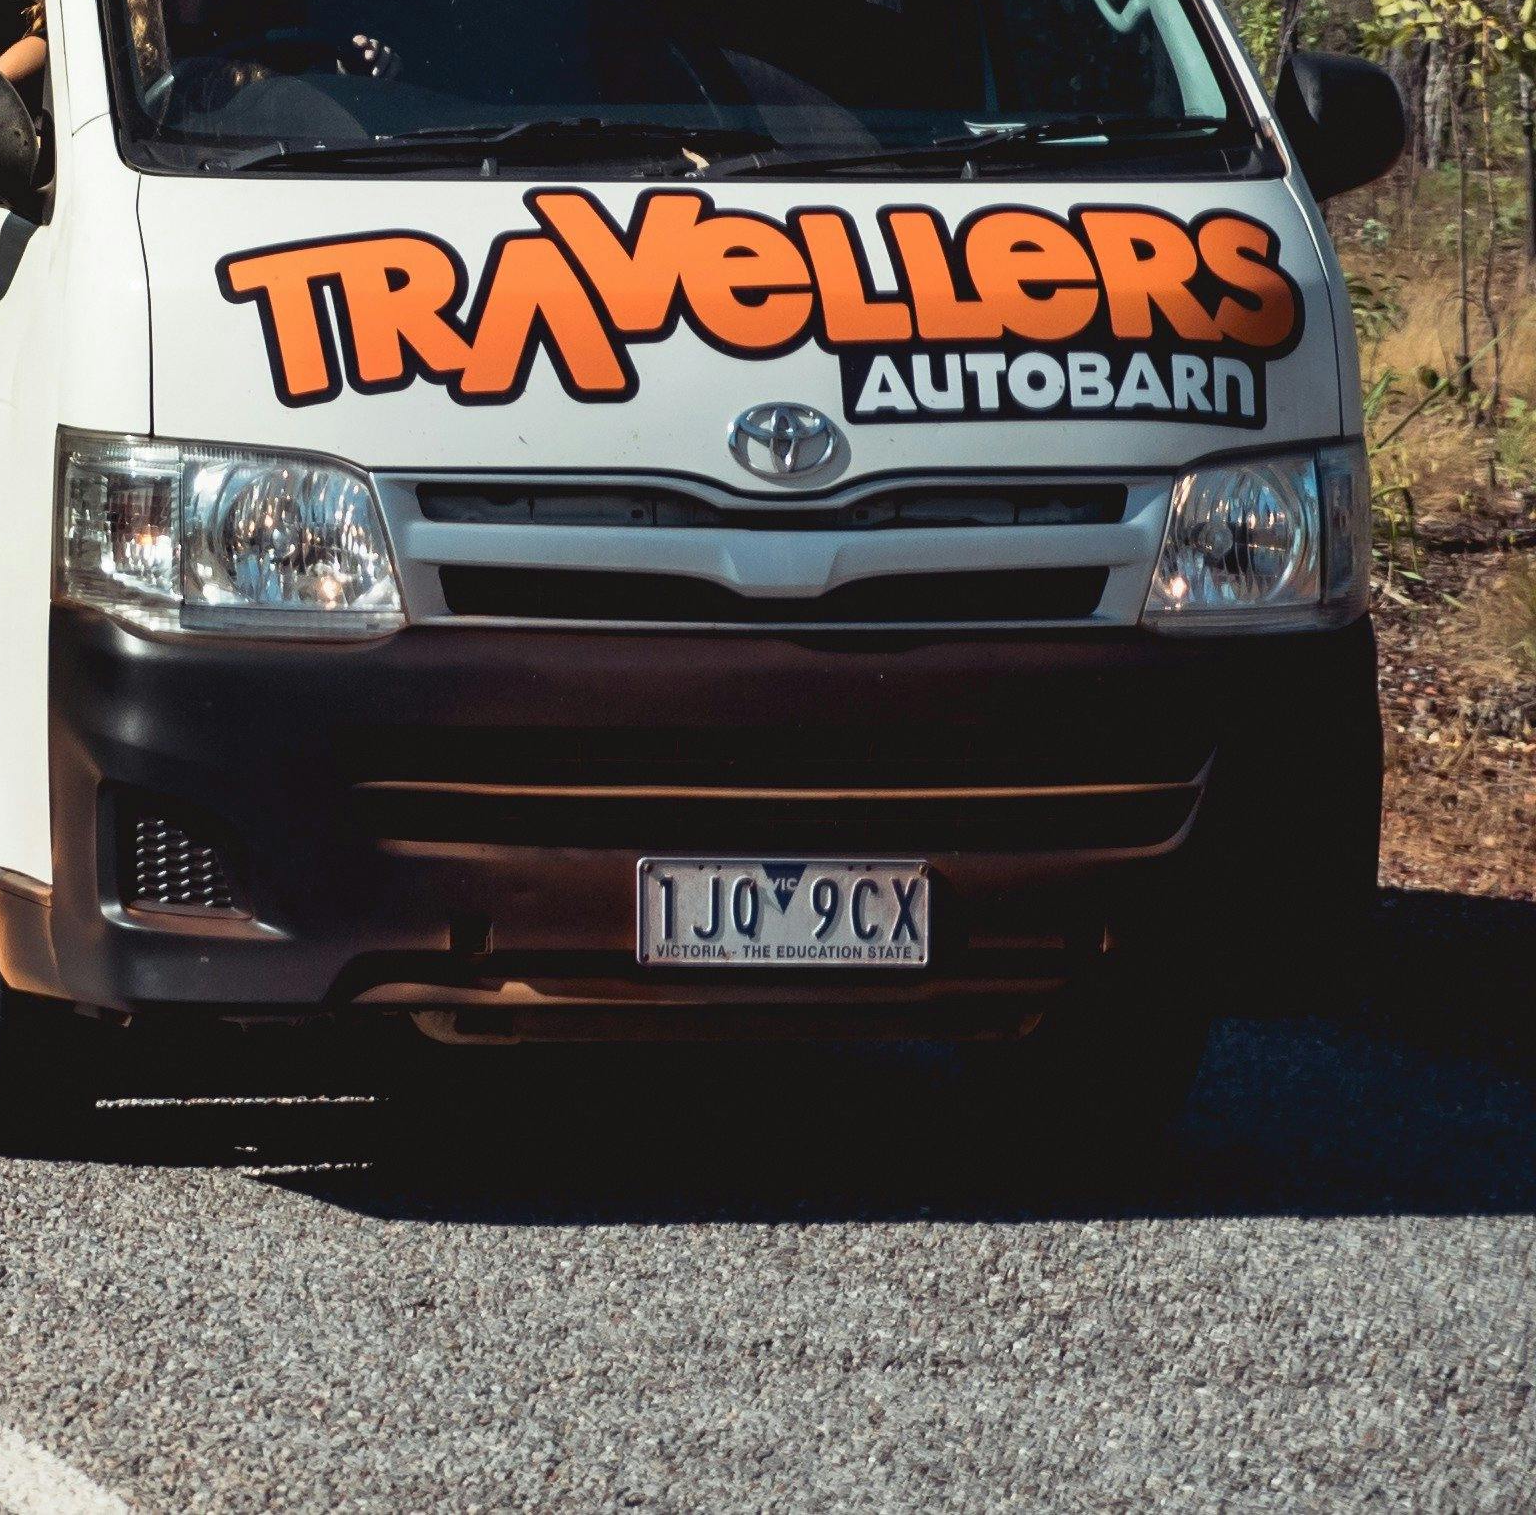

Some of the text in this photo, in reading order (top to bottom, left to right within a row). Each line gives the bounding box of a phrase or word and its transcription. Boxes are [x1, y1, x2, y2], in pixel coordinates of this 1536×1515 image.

[656, 945, 726, 959] VICTORIA
[743, 945, 771, 959] THE
[776, 945, 862, 959] EDUCATION
[868, 945, 912, 959] STATE
